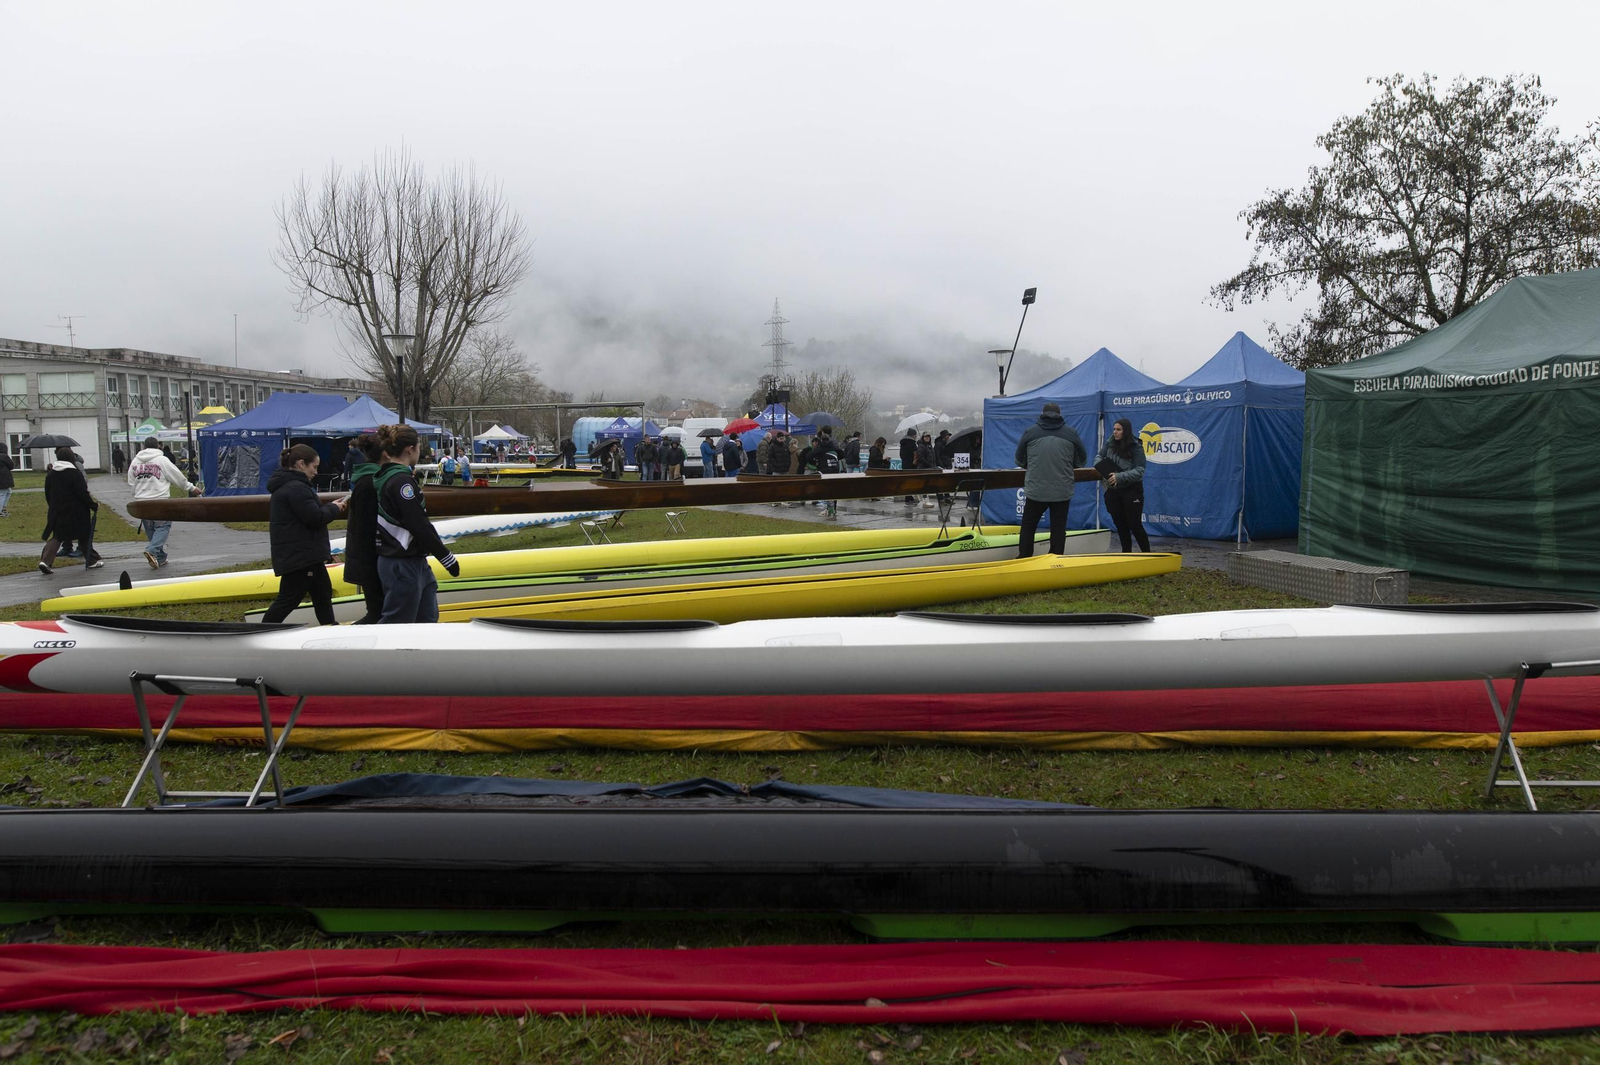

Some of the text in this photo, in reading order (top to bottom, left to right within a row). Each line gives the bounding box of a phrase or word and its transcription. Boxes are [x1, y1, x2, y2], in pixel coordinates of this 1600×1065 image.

[1353, 360, 1600, 393] ESCUELA PIRAGUISMO CIUDAD DE PONTE
[1113, 390, 1231, 406] CLUB PIRAGÜISMO OLIVICO
[1146, 441, 1195, 454] MASCATO
[956, 456, 970, 464] 354
